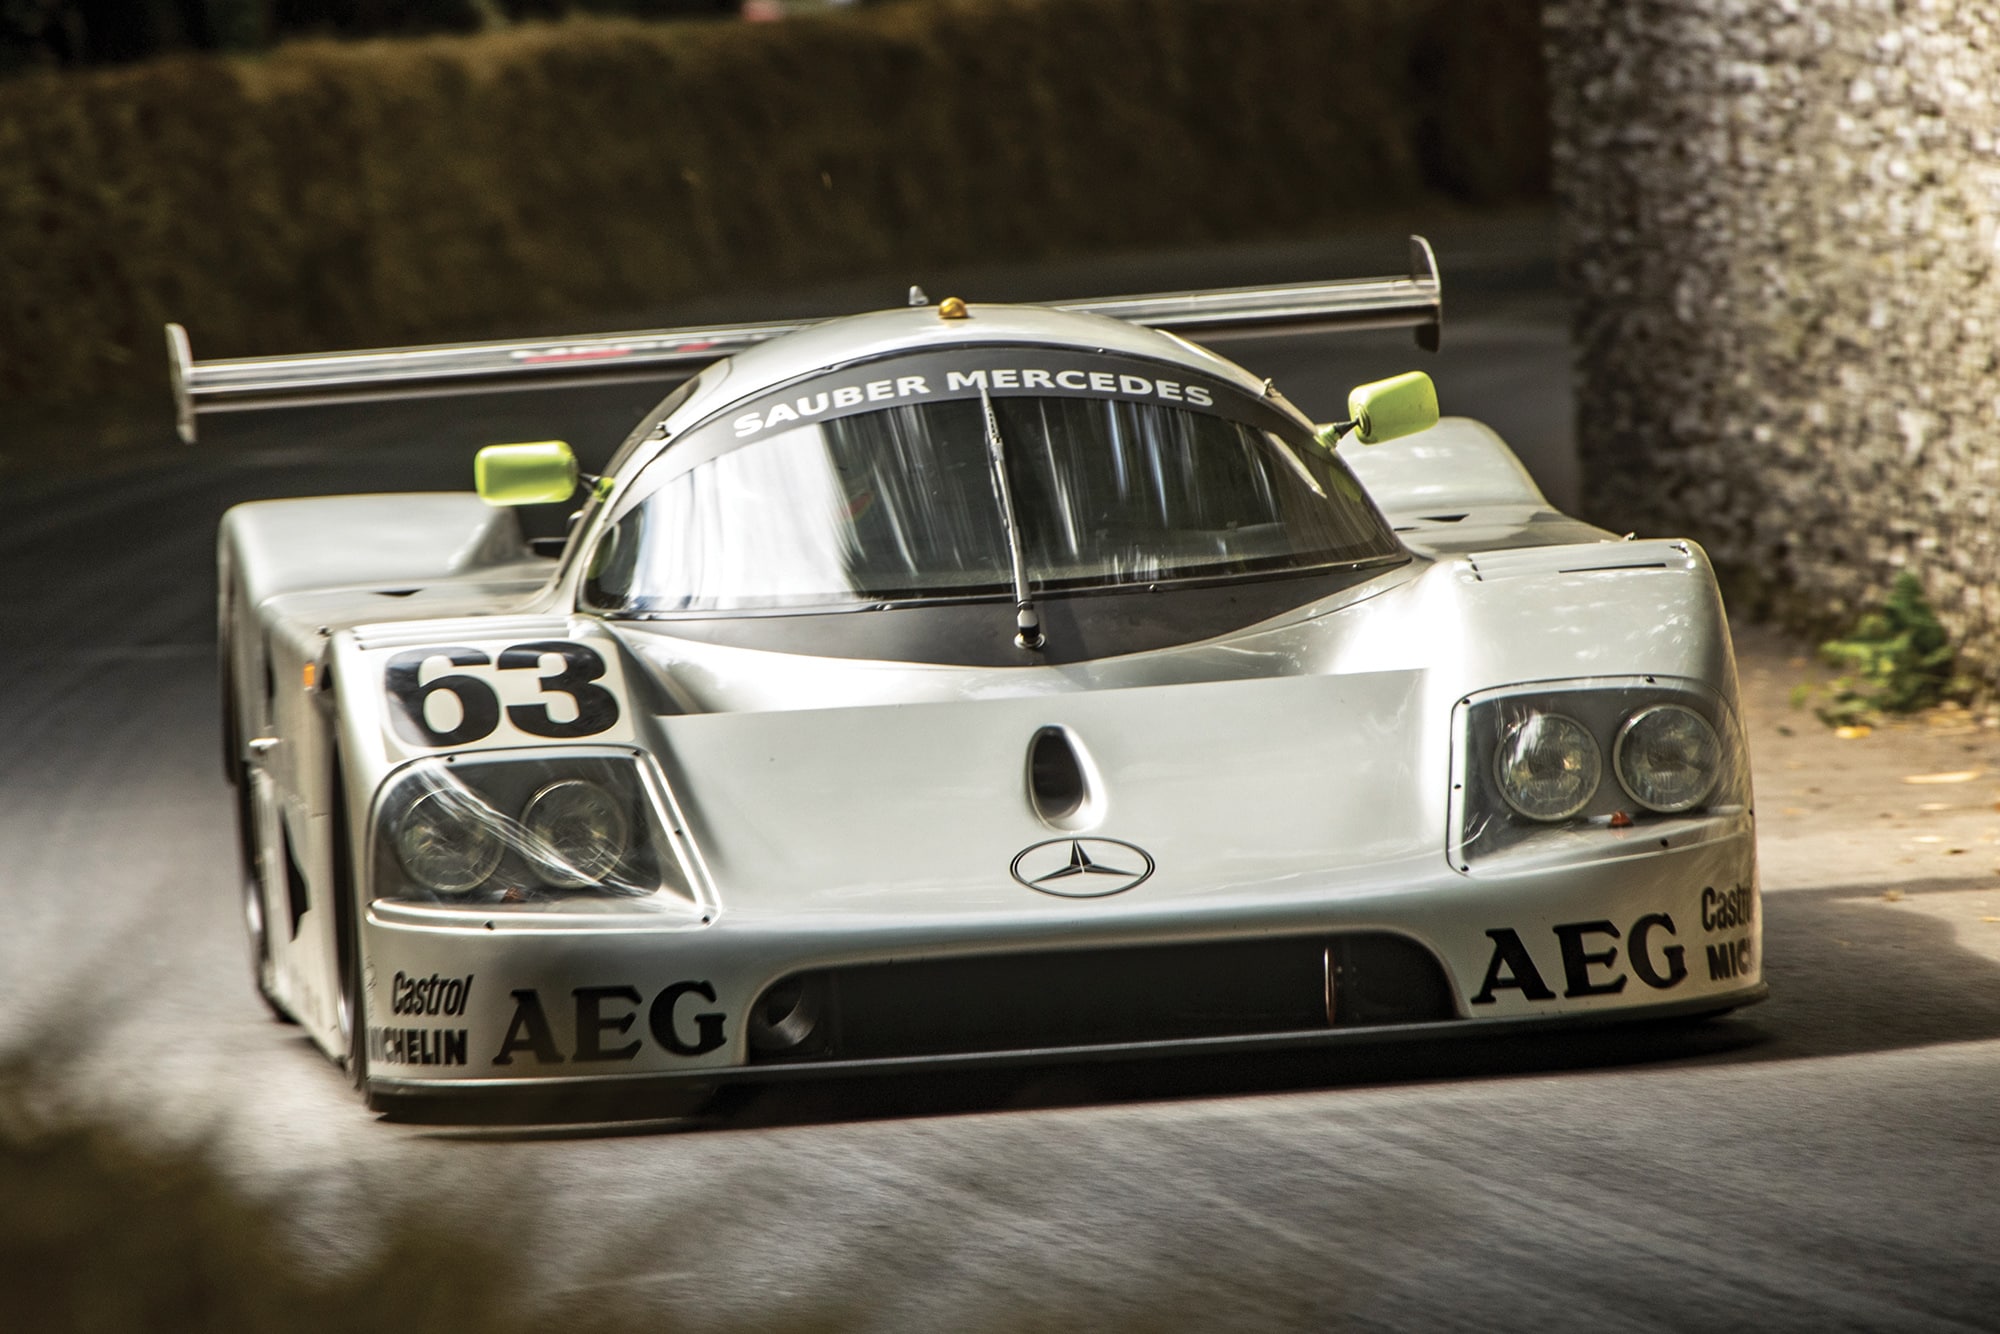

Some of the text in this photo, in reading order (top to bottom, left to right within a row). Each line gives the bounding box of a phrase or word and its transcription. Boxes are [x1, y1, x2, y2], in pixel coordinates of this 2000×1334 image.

[733, 369, 1214, 437] SAUBER MERCEDES
[384, 640, 619, 747] 63
[392, 970, 475, 1016] Castrol
[1470, 912, 1688, 1005] AEG
[492, 980, 727, 1065] AEG
